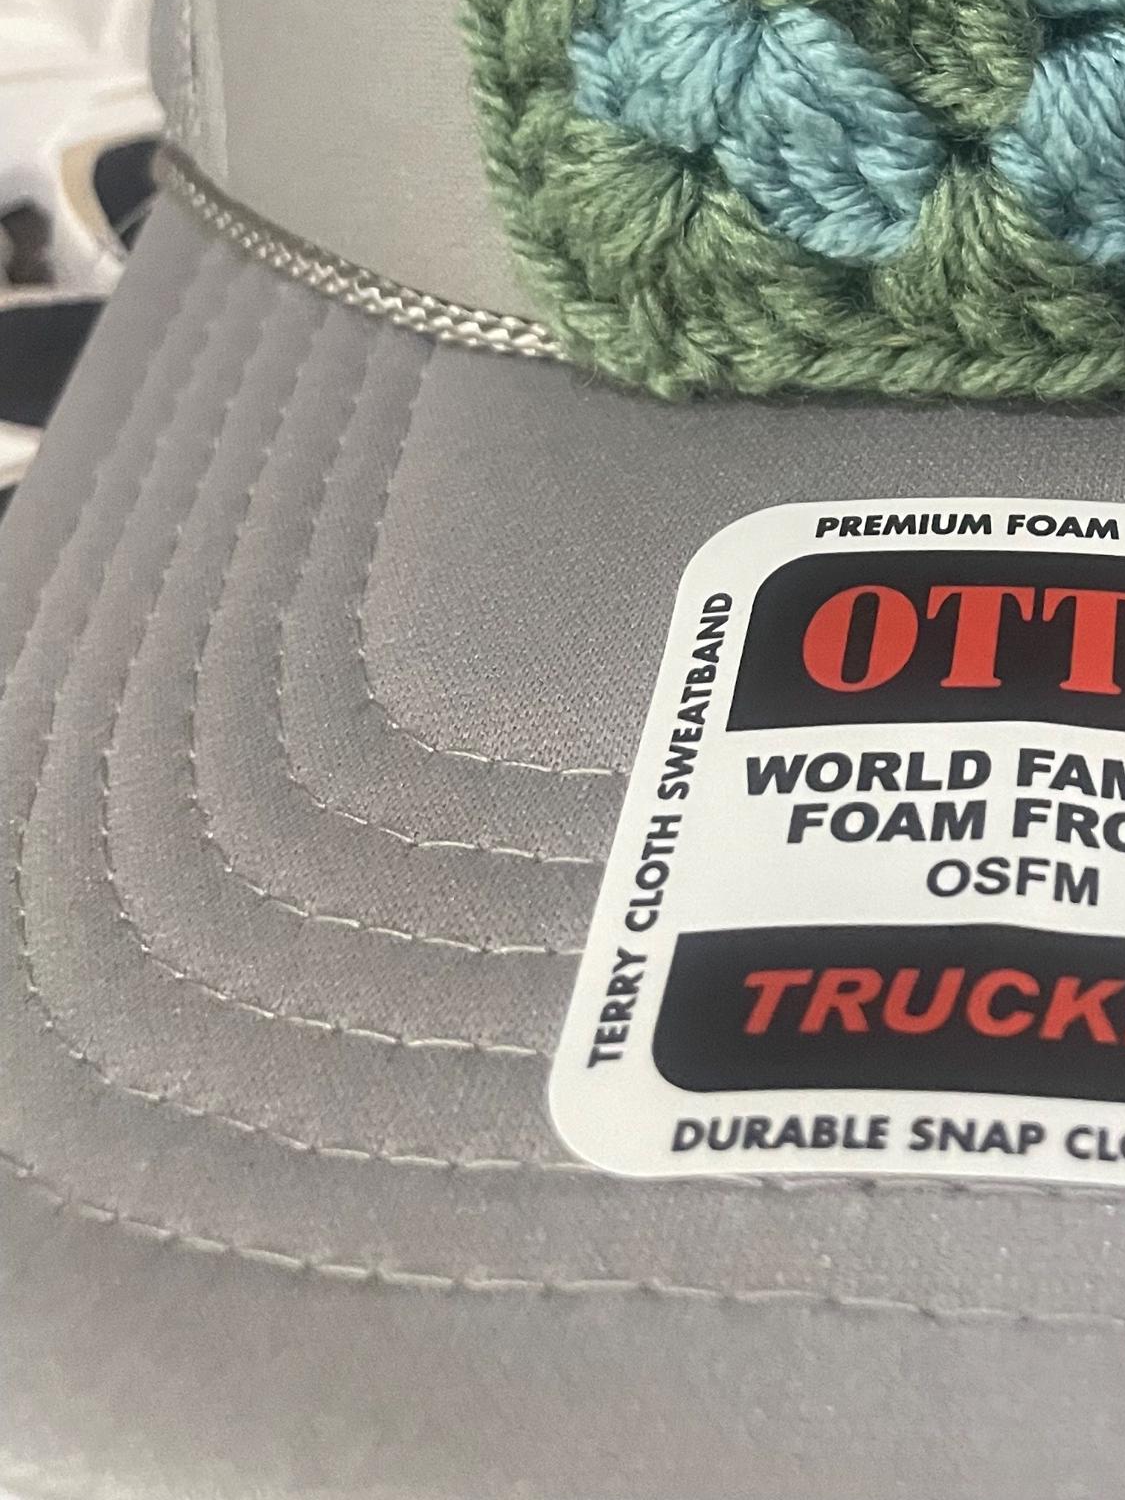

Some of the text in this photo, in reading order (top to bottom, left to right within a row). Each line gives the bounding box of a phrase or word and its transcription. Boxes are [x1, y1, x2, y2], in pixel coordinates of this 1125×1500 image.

[815, 513, 992, 539] PREMIUM
[1006, 514, 1120, 540] FOAM
[746, 749, 992, 796] WORLD
[587, 592, 733, 1068] TERRY CLOTH SWEATBAND
[786, 799, 987, 844] FOAM
[926, 856, 1099, 907] OSFM
[671, 1116, 889, 1152] DURABLE
[909, 1117, 1045, 1155] SNAP
